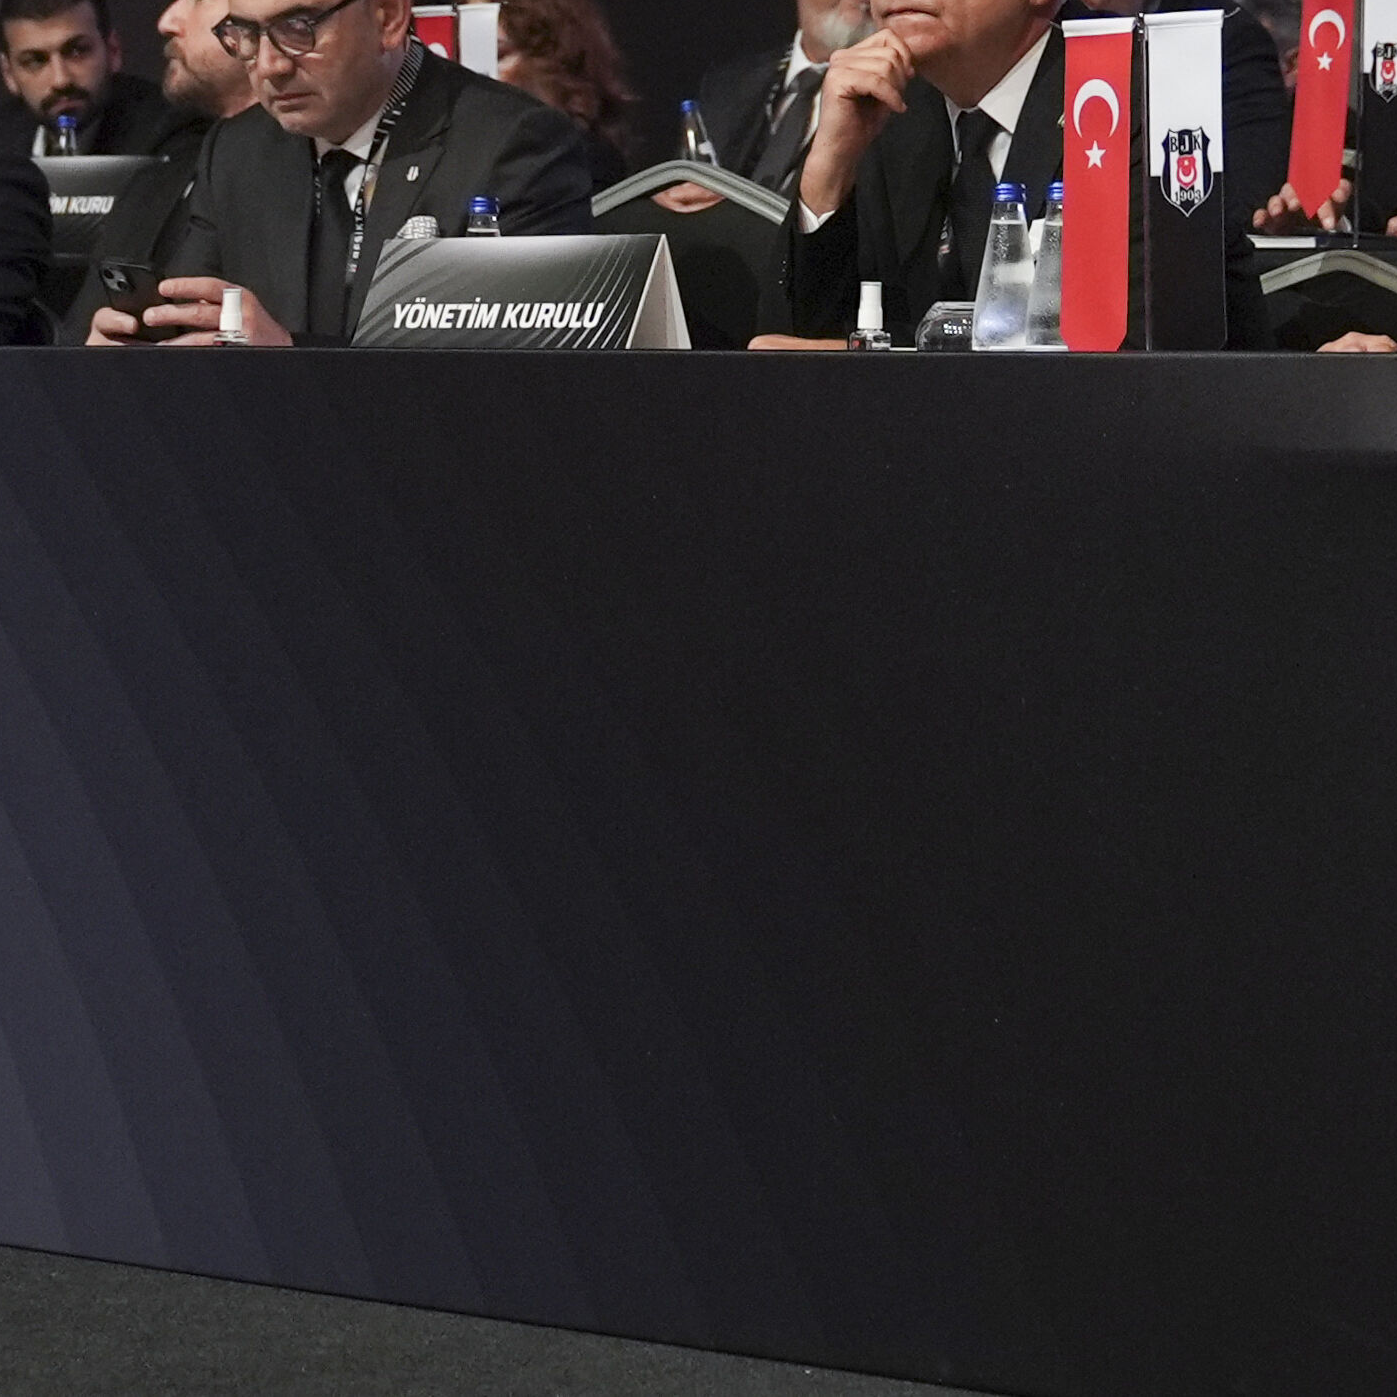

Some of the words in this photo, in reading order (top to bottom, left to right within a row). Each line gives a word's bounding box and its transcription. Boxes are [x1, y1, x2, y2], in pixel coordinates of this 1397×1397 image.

[68, 196, 115, 214] KURU
[394, 297, 501, 329] YÖNETİM
[501, 303, 605, 329] KURULU
